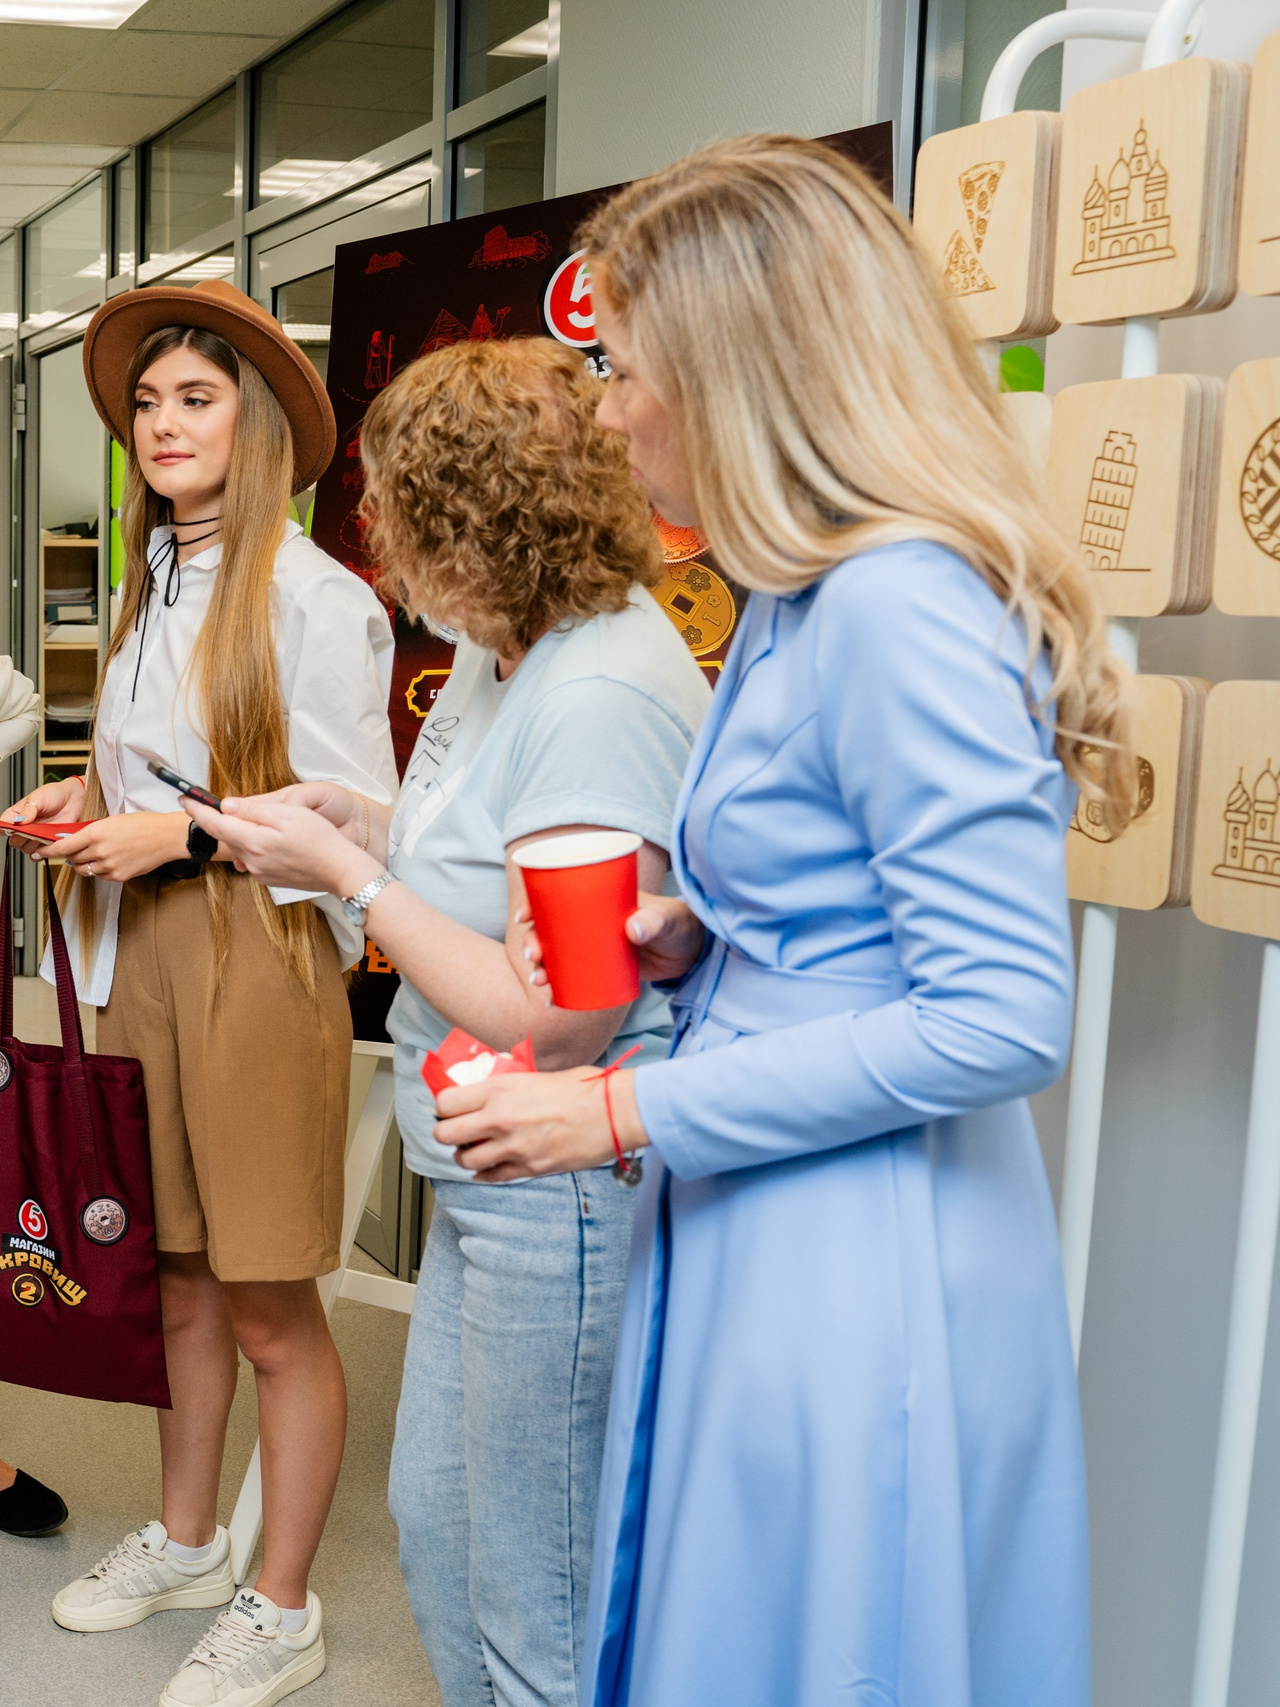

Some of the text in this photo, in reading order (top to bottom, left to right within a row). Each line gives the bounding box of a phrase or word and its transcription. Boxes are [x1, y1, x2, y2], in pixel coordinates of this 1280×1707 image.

[27, 1205, 42, 1233] 5
[9, 1236, 56, 1260] МАГАЗИН
[19, 1281, 37, 1301] 2
[233, 1604, 256, 1620] adidas
